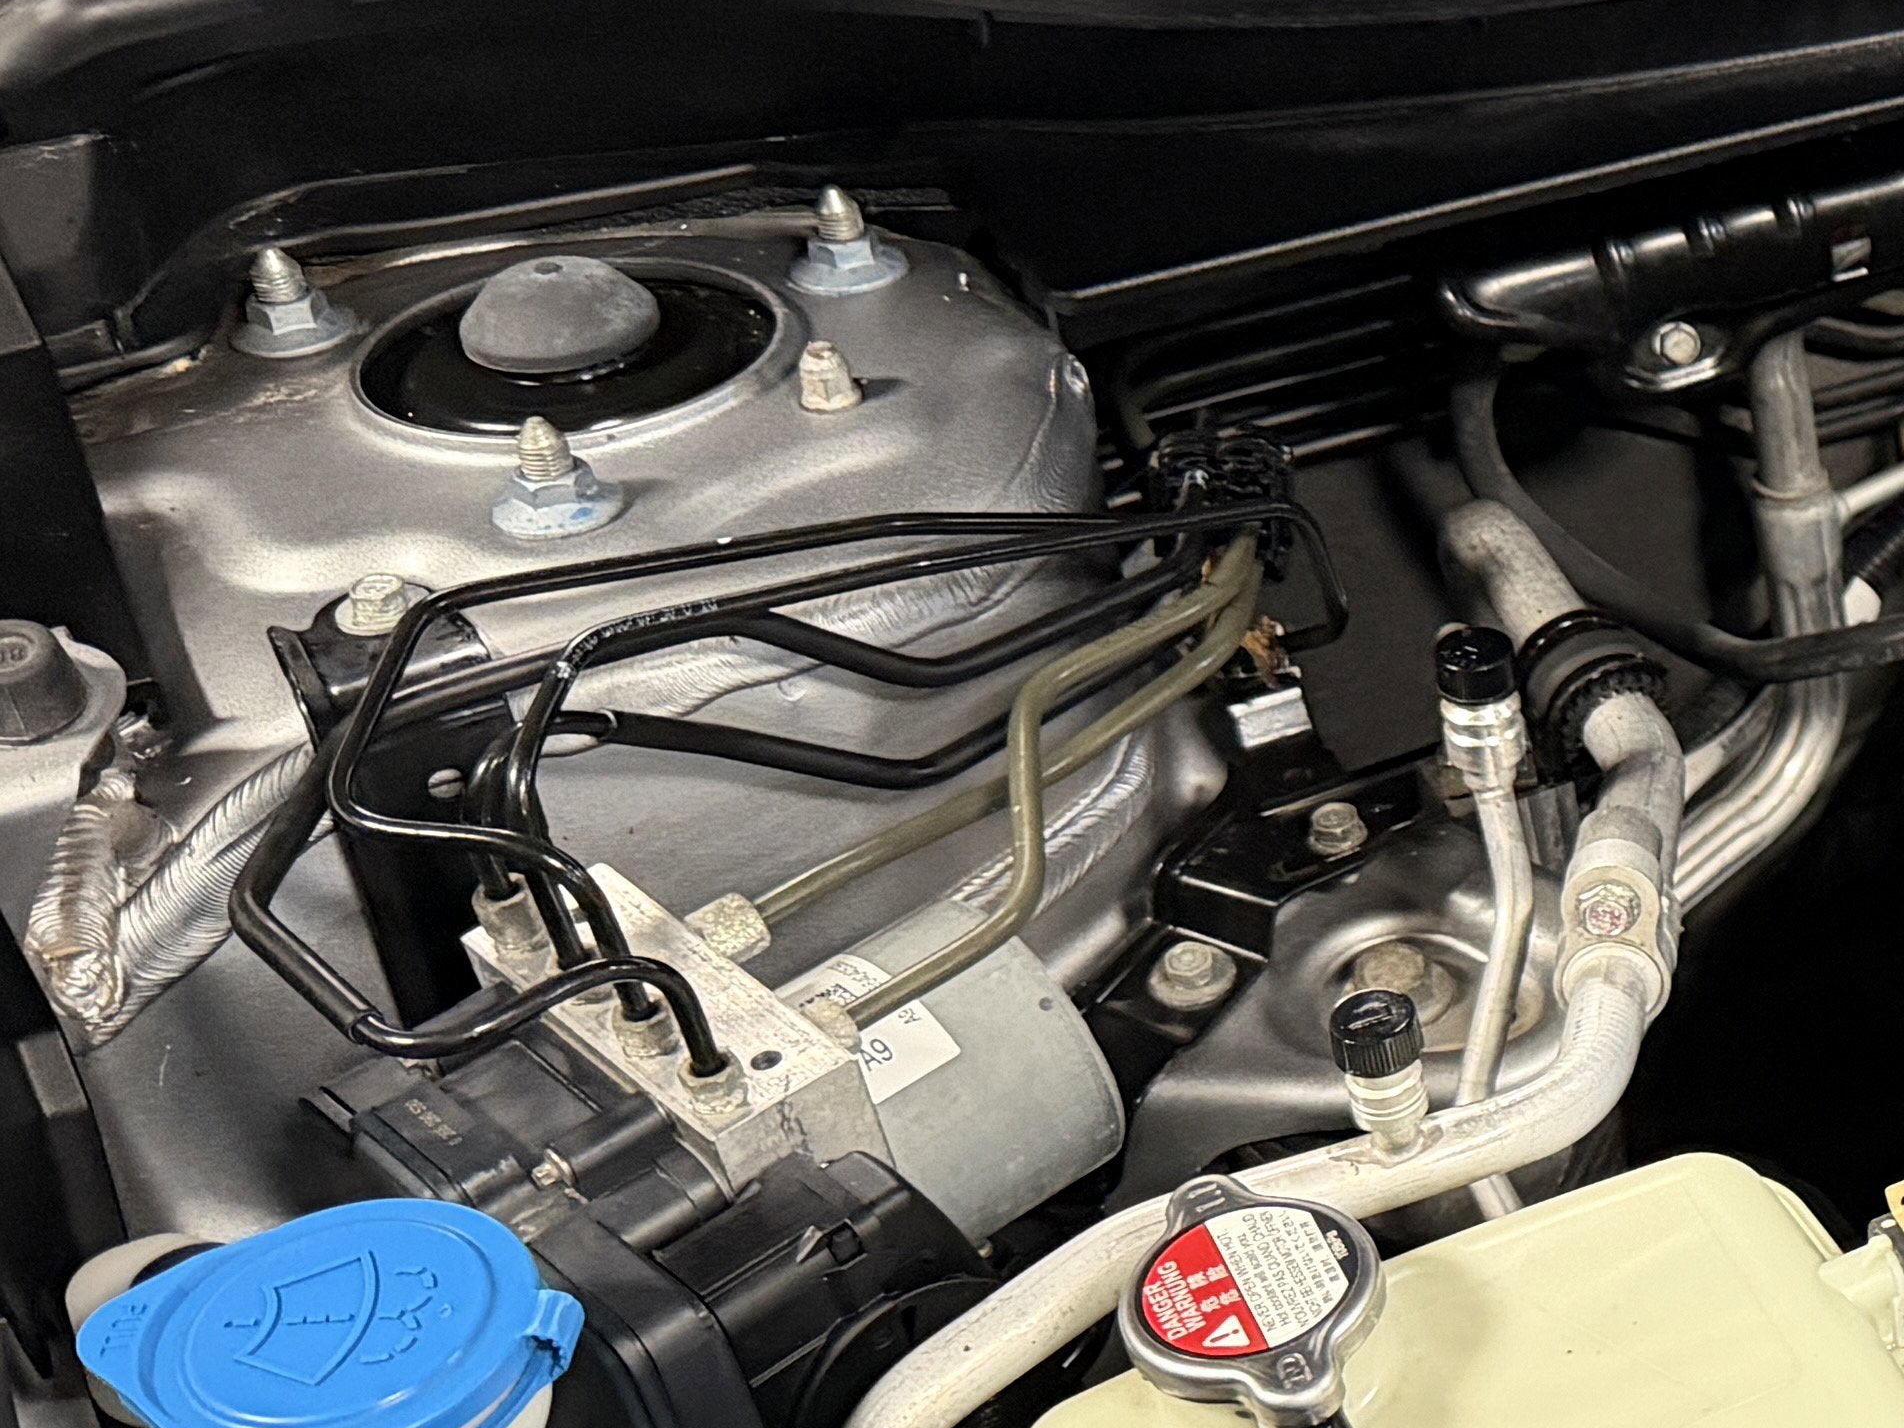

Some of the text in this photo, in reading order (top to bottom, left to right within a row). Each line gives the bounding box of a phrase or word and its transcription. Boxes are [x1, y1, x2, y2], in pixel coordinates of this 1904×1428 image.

[858, 1038, 893, 1072] A9
[1143, 1280, 1188, 1341] DANGER
[1157, 1261, 1206, 1333] WARNUNG
